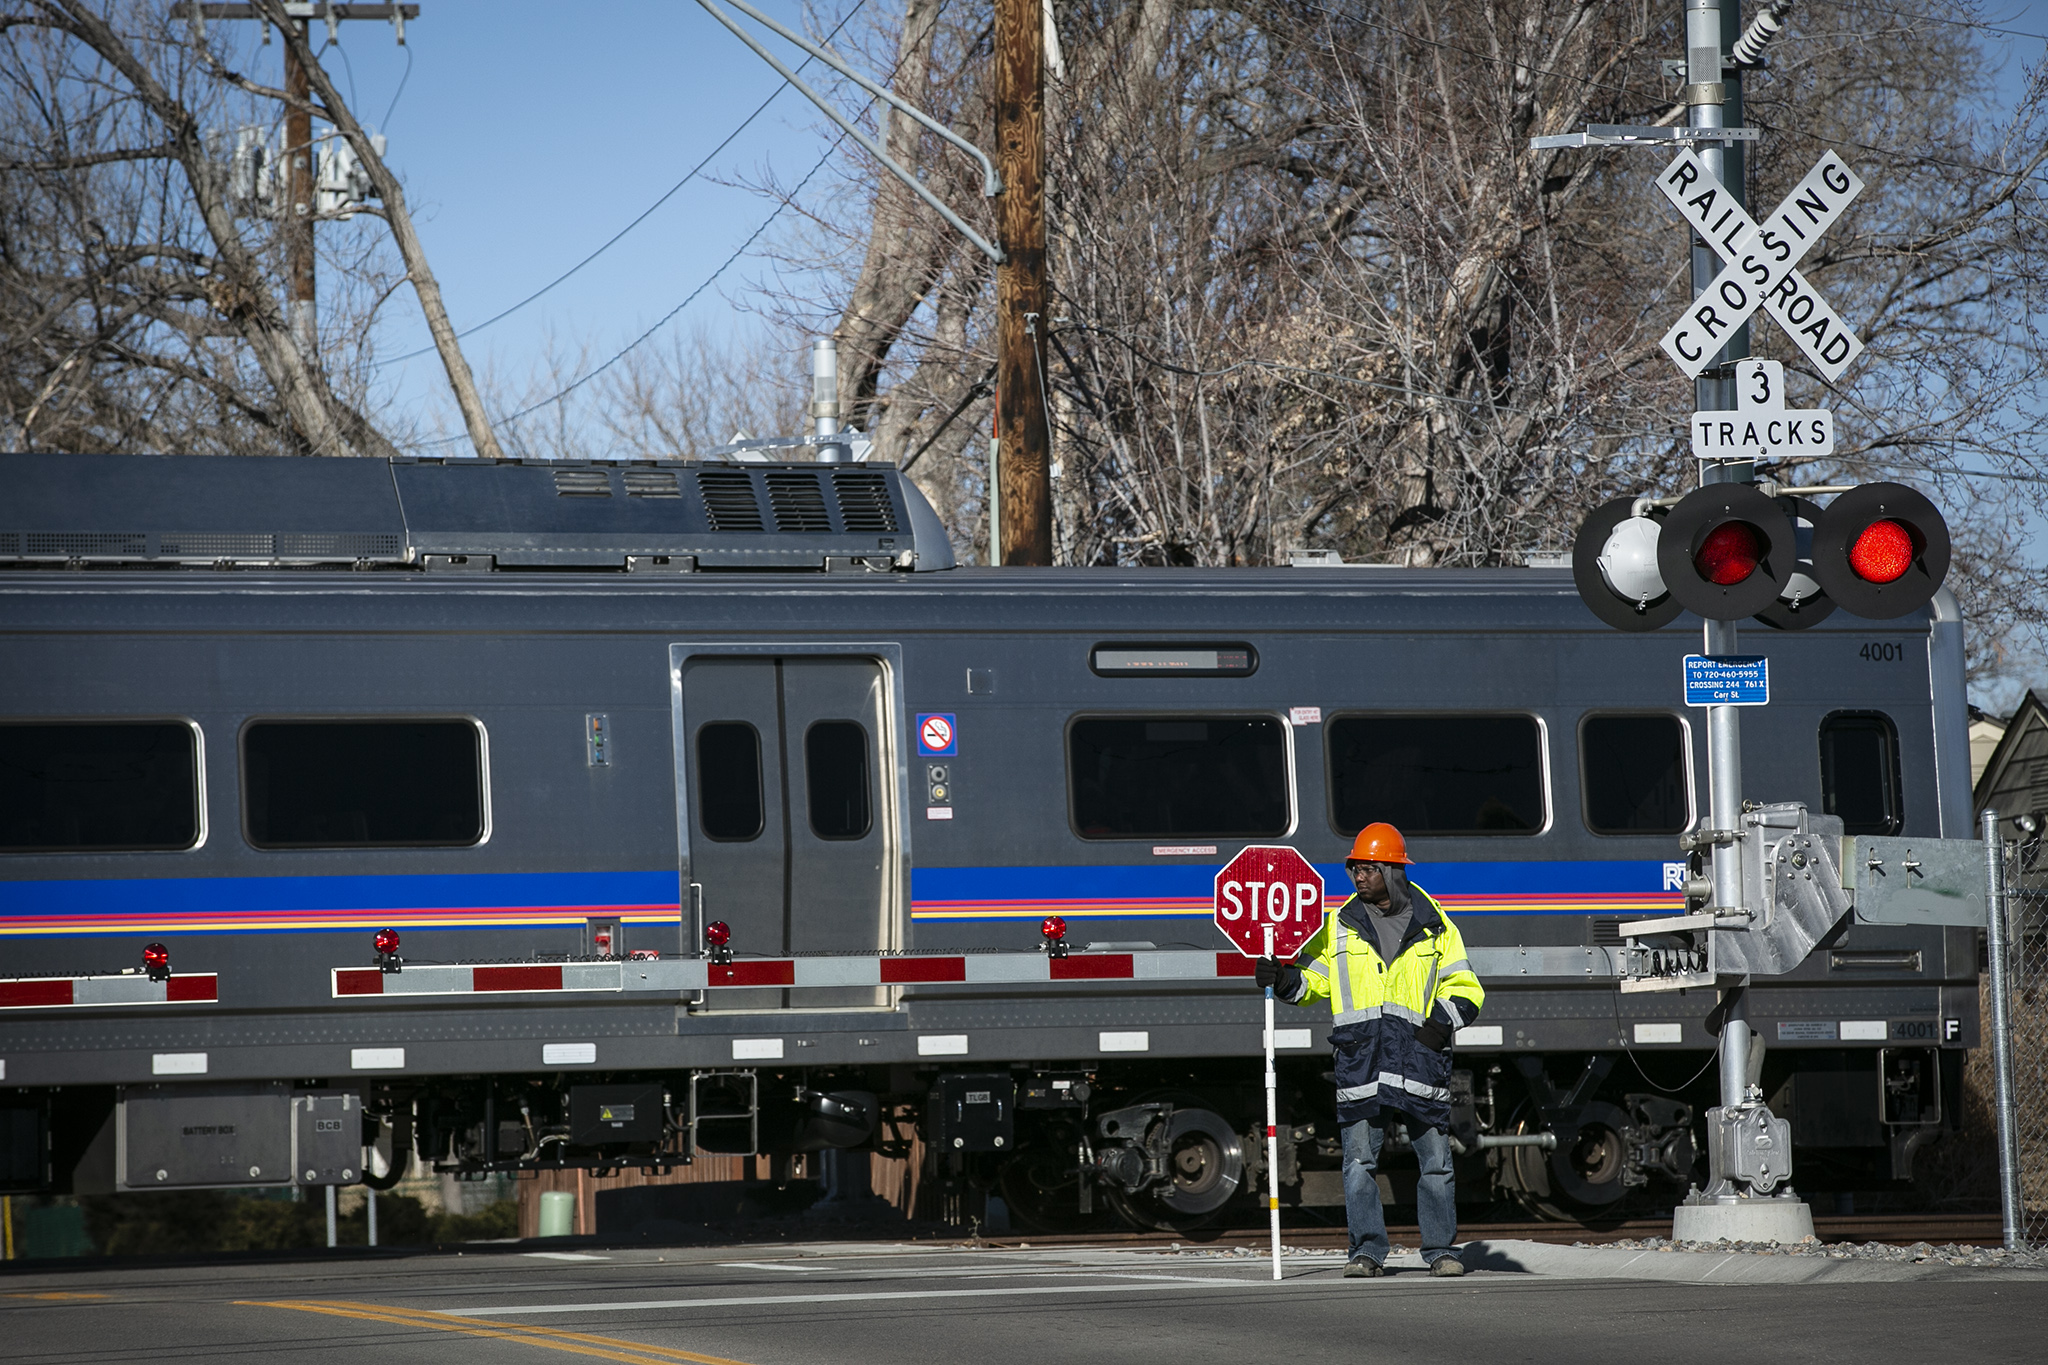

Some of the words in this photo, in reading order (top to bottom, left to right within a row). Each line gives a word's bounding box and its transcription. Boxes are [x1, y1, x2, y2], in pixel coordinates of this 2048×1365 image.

[1668, 160, 1745, 257] RAIL
[1770, 272, 1850, 365] ROAD
[1674, 163, 1850, 362] CROSSING
[1750, 371, 1771, 404] 3
[1699, 420, 1826, 447] TRACKS
[1859, 642, 1903, 661] 4001
[1221, 880, 1318, 922] STOP
[1896, 1023, 1934, 1038] 4001
[1946, 1020, 1959, 1040] F
[183, 1126, 216, 1135] BATTERY
[218, 1125, 234, 1134] BOX
[317, 1121, 340, 1130] BCB
